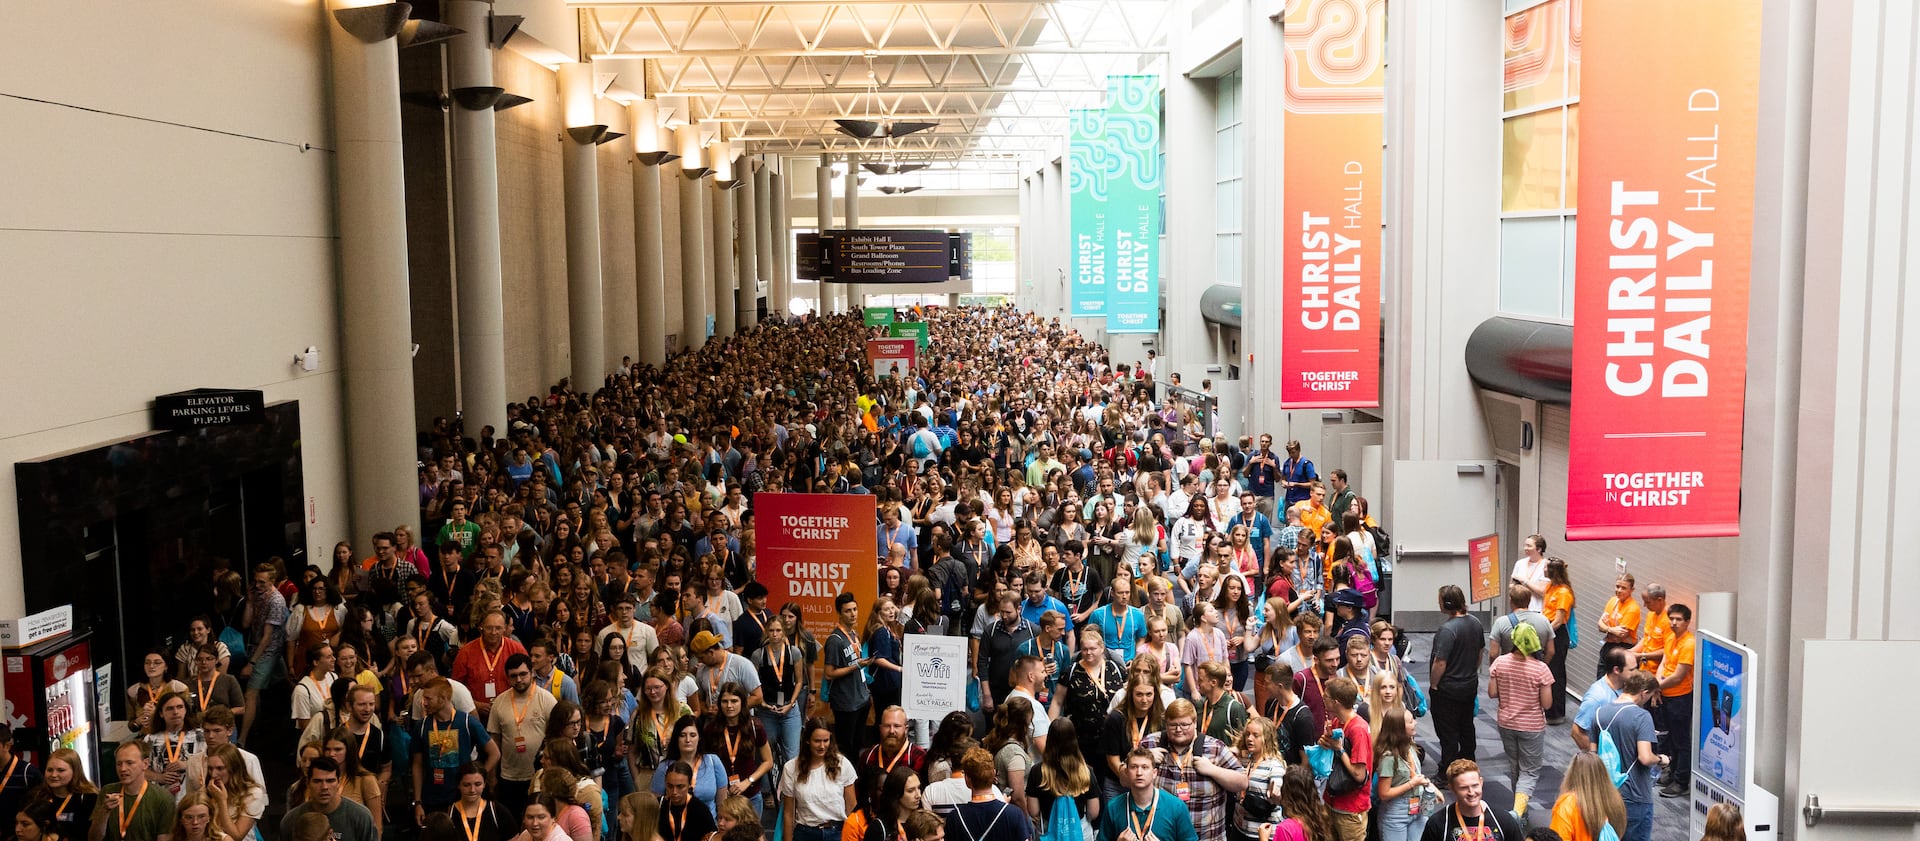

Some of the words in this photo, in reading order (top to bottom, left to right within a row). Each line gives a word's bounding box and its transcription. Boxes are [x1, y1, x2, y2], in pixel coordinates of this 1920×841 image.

[1688, 88, 1720, 112] D
[1344, 161, 1363, 174] D
[1684, 124, 1719, 211] HALL
[1343, 180, 1362, 229] HALL
[1096, 220, 1105, 241] HALL
[1138, 213, 1149, 239] HALL
[824, 248, 828, 260] 1
[953, 248, 957, 260] 1
[1079, 233, 1091, 284] CHRIST
[1092, 242, 1105, 284] DAILY
[1117, 229, 1132, 292] CHRIST
[863, 267, 886, 275] Loading
[1133, 241, 1149, 292] DAILY
[1301, 211, 1330, 330] CHRIST
[1333, 232, 1361, 330] DAILY
[1604, 180, 1660, 397] CHRIST
[1661, 220, 1715, 398] DAILY
[1301, 371, 1359, 381] TOGETHER
[1311, 381, 1351, 391] CHRIST
[187, 396, 235, 406] ELEVATOR
[172, 406, 215, 417] PARKING
[218, 404, 251, 413] LEVELS
[1603, 471, 1704, 490] TOGETHER
[1605, 491, 1617, 503] IN
[1619, 489, 1691, 508] CHRIST
[780, 515, 849, 528] TOGETHER
[792, 528, 840, 540] CHRIST
[782, 562, 851, 580] CHRIST
[789, 580, 846, 598] DAILY
[802, 604, 824, 614] HALL
[826, 605, 833, 614] D
[29, 631, 38, 639] get
[917, 662, 951, 679] Wifi
